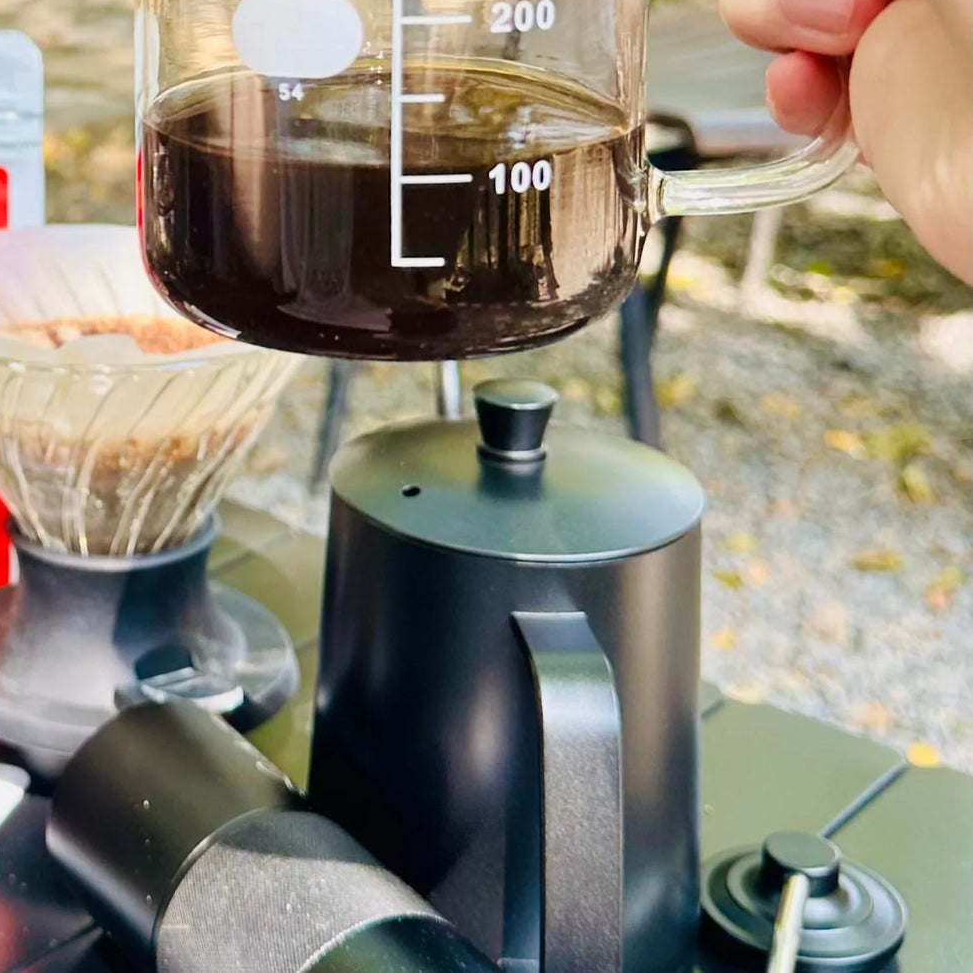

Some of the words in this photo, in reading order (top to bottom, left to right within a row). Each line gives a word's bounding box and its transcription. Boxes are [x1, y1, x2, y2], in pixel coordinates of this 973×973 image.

[490, 0, 556, 34] 200
[278, 82, 304, 102] 54
[489, 159, 553, 195] 100
